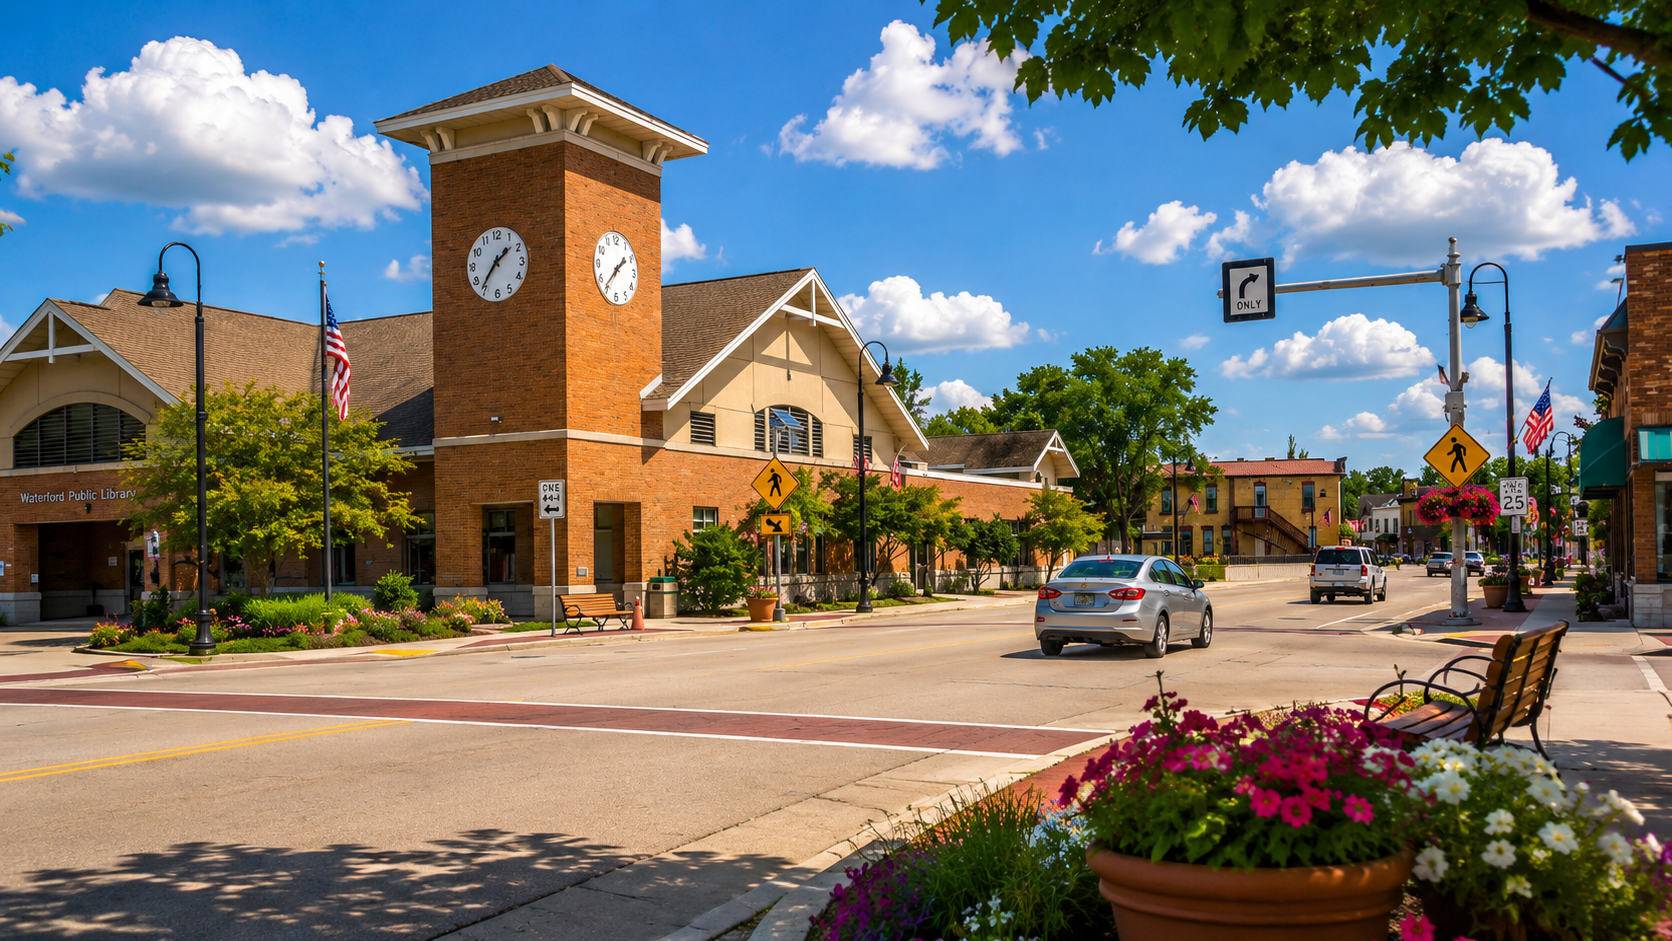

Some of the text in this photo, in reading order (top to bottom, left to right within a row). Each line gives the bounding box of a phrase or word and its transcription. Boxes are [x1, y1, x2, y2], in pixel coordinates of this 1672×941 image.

[493, 230, 501, 240] 12
[482, 236, 489, 246] 11
[612, 235, 619, 246] 12
[473, 247, 482, 258] 10
[516, 243, 521, 252] 2
[519, 256, 525, 266] 3
[632, 269, 636, 278] 3
[494, 289, 500, 298] 6
[506, 284, 512, 294] 5
[614, 292, 618, 302] 6
[1237, 300, 1261, 310] ONLY
[68, 490, 98, 501] Public
[101, 488, 136, 501] Library
[1504, 496, 1524, 510] 25
